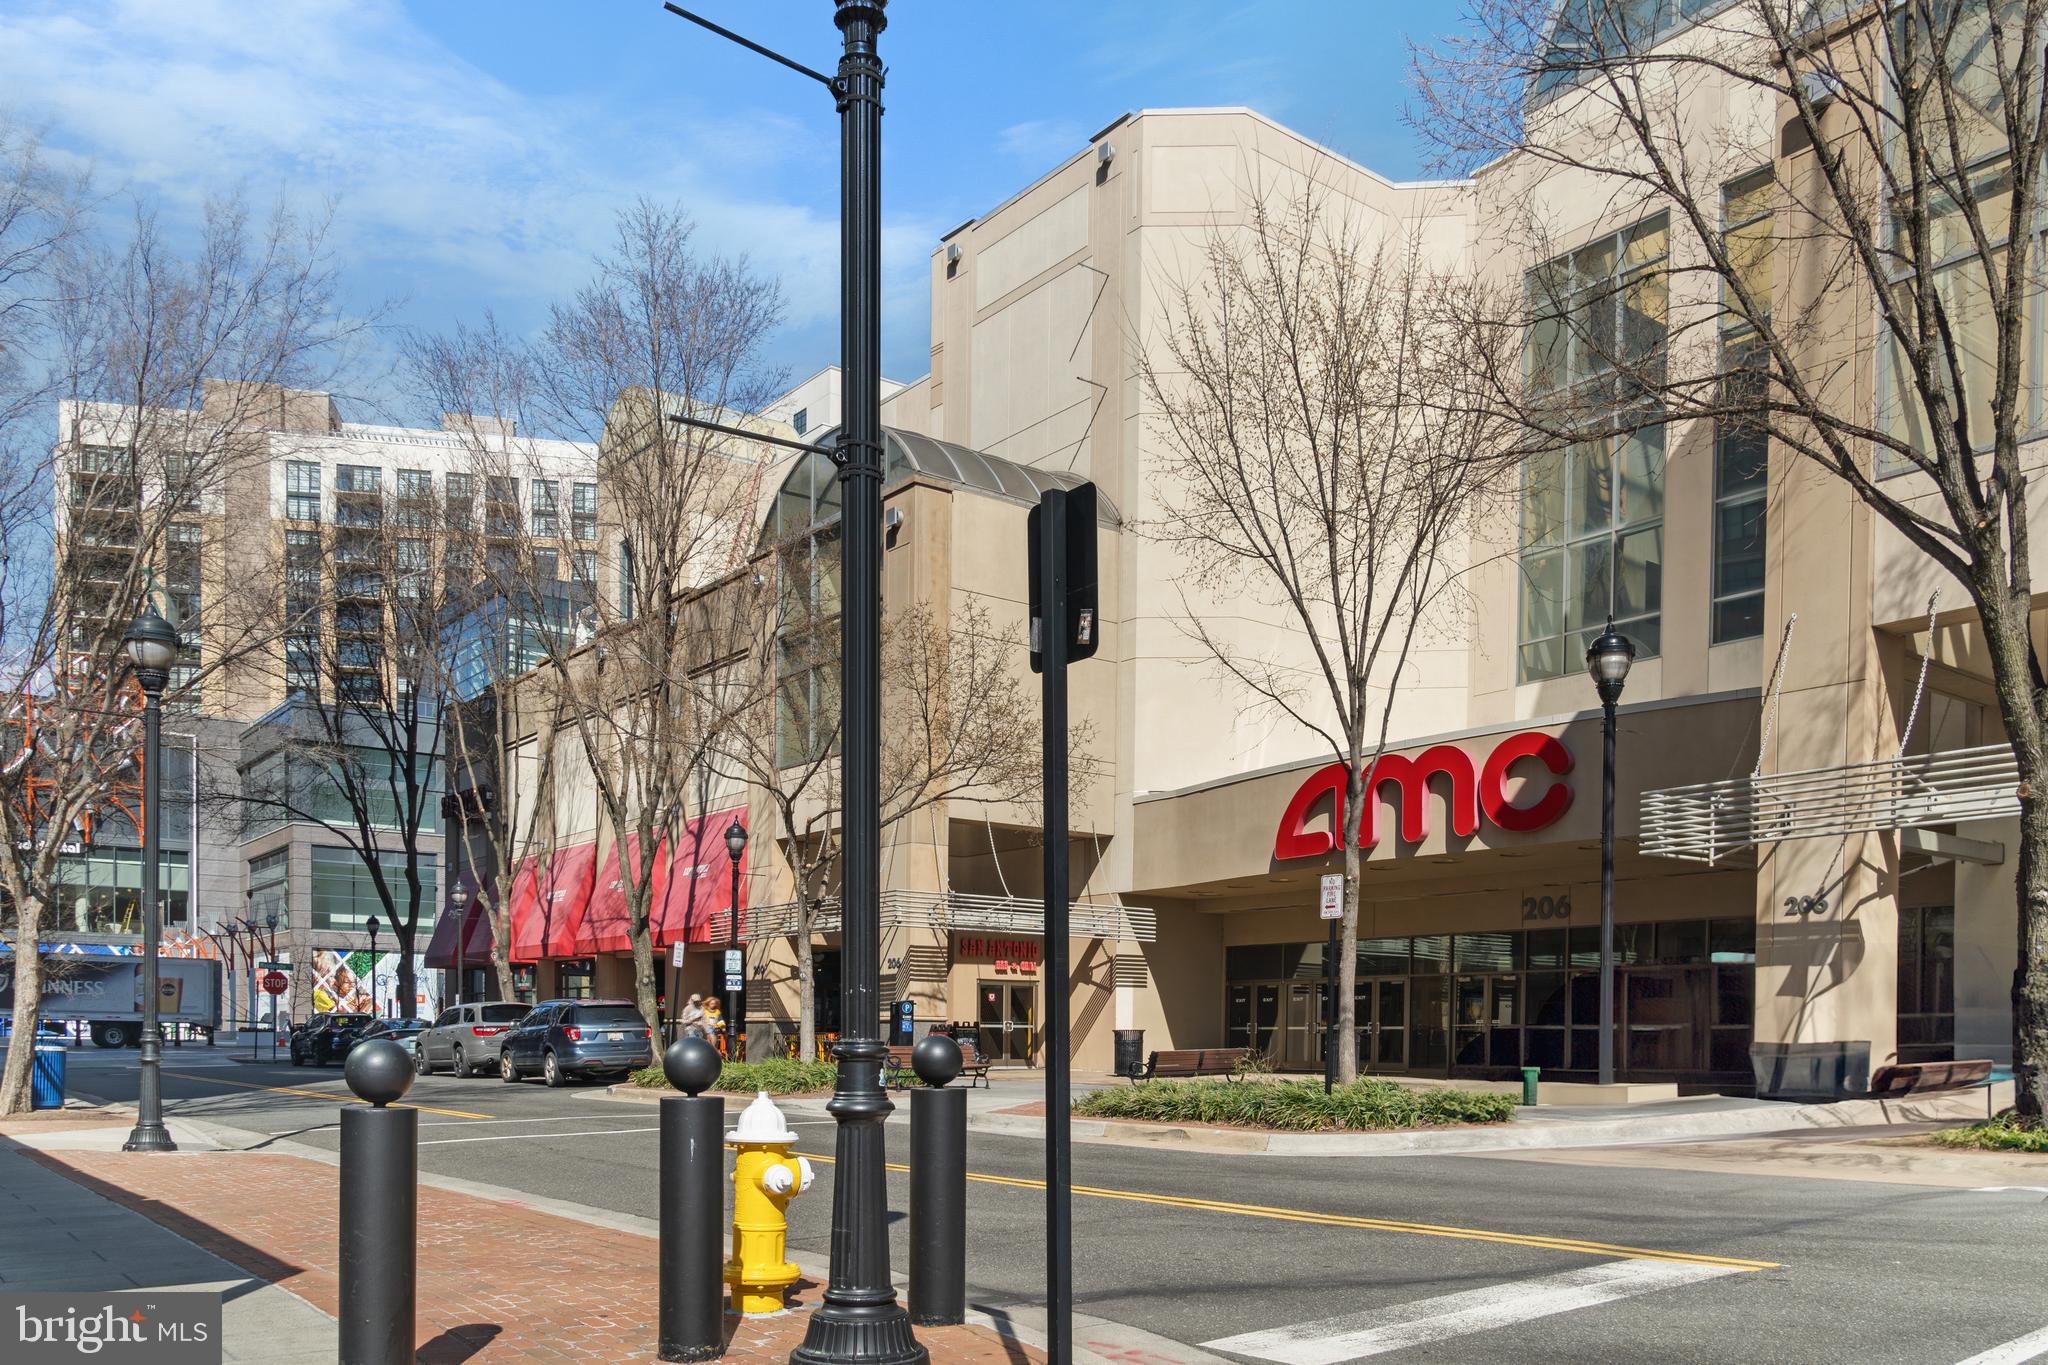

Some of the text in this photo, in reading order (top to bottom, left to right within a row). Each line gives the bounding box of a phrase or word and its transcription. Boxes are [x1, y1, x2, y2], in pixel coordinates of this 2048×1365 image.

[1524, 895, 1572, 920] 206
[1784, 896, 1828, 916] 206
[961, 938, 1039, 960] SAN ANTONIO
[264, 978, 287, 988] STOP
